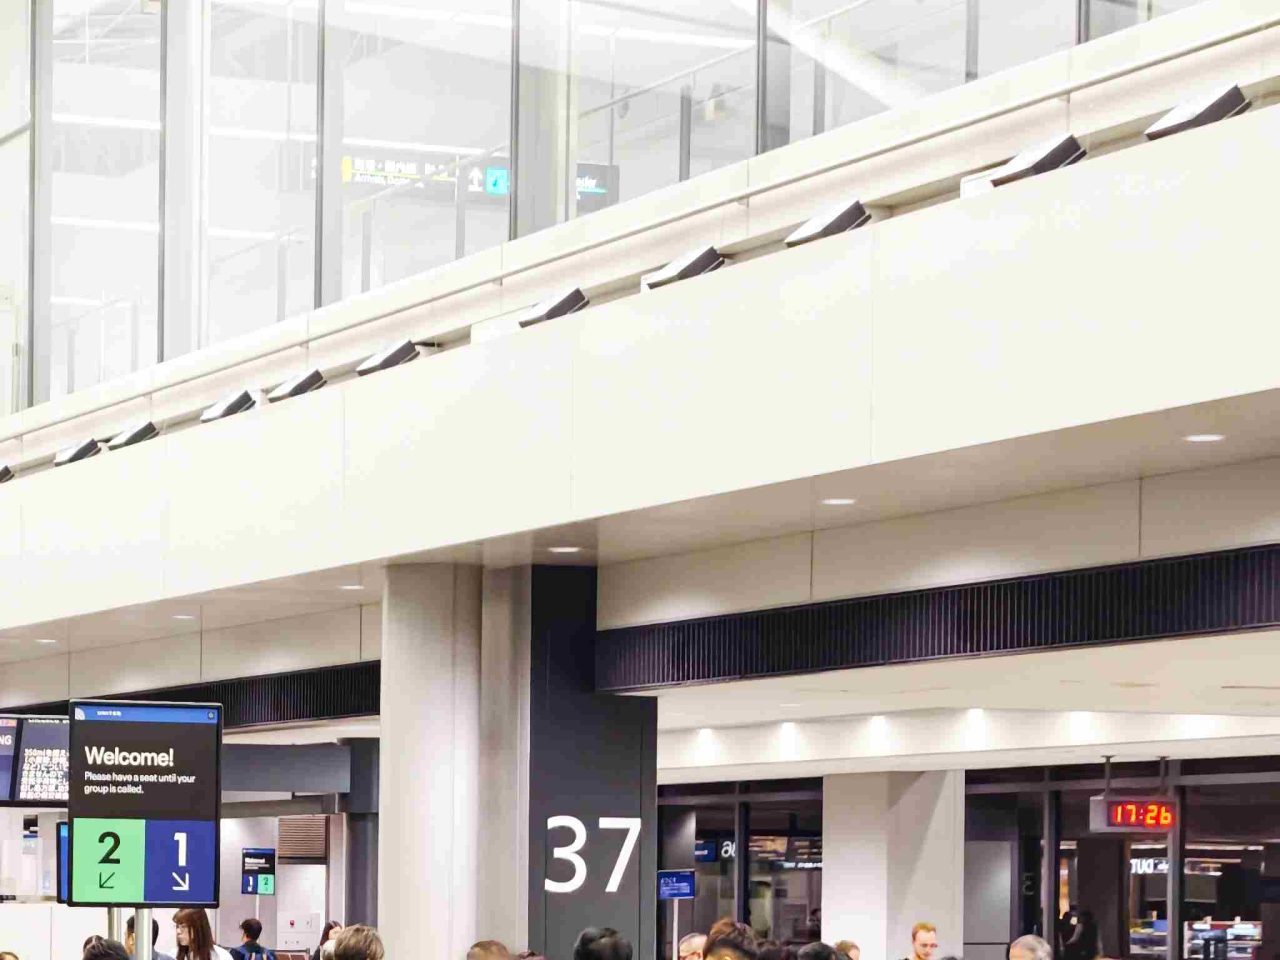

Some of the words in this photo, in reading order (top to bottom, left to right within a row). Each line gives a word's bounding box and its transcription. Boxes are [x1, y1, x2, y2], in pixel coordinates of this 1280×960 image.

[84, 745, 175, 767] Welcome!
[84, 770, 112, 781] Please
[112, 771, 133, 782] have
[133, 774, 139, 782] a
[139, 773, 158, 783] seat
[158, 772, 177, 783] until
[177, 775, 196, 785] your
[83, 784, 109, 795] group
[109, 783, 117, 794] is
[117, 783, 145, 795] called.
[1114, 804, 1172, 825] 17:26
[98, 831, 121, 865] 2
[173, 831, 188, 867] 1
[543, 815, 642, 893] 37
